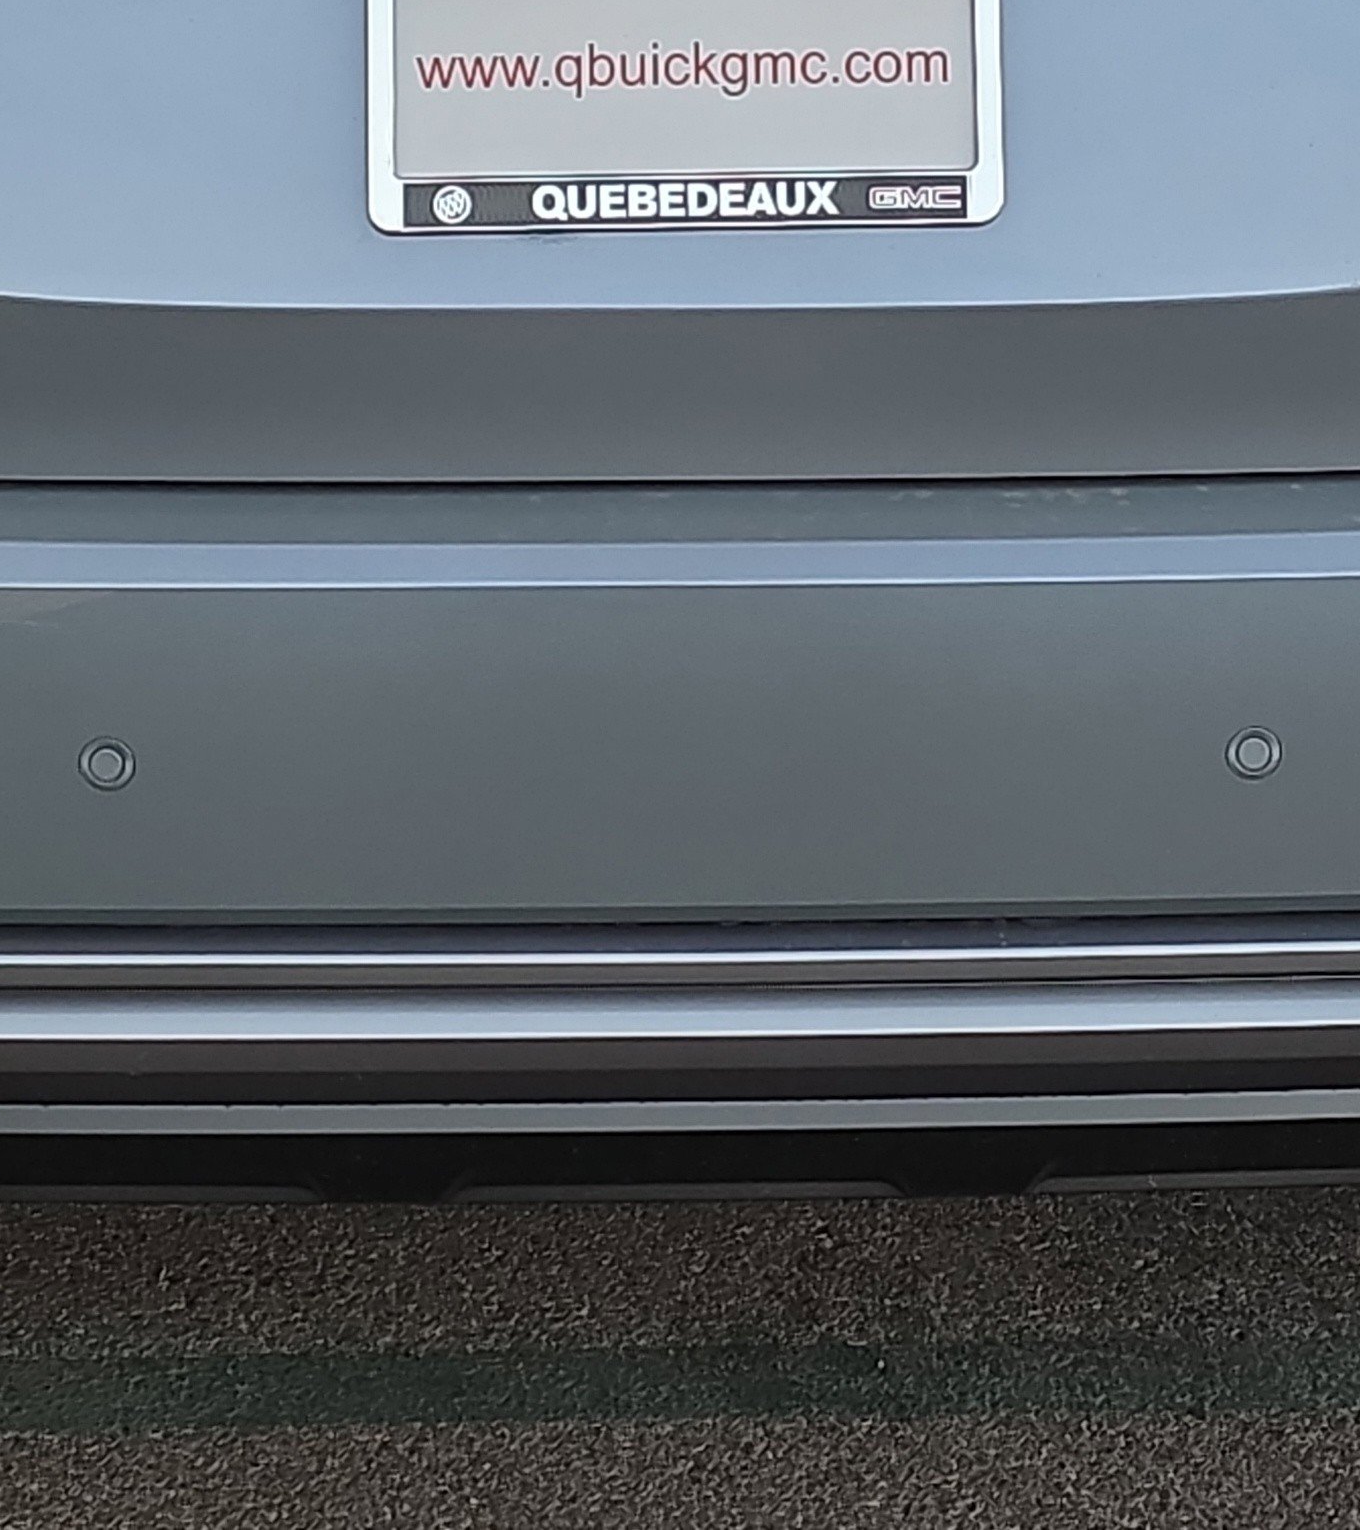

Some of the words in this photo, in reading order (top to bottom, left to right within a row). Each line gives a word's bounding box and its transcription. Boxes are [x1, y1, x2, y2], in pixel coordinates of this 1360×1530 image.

[415, 41, 950, 99] www.qbuickgmc.com
[531, 180, 840, 221] QUEBEDEAUX
[868, 184, 962, 209] GMC
